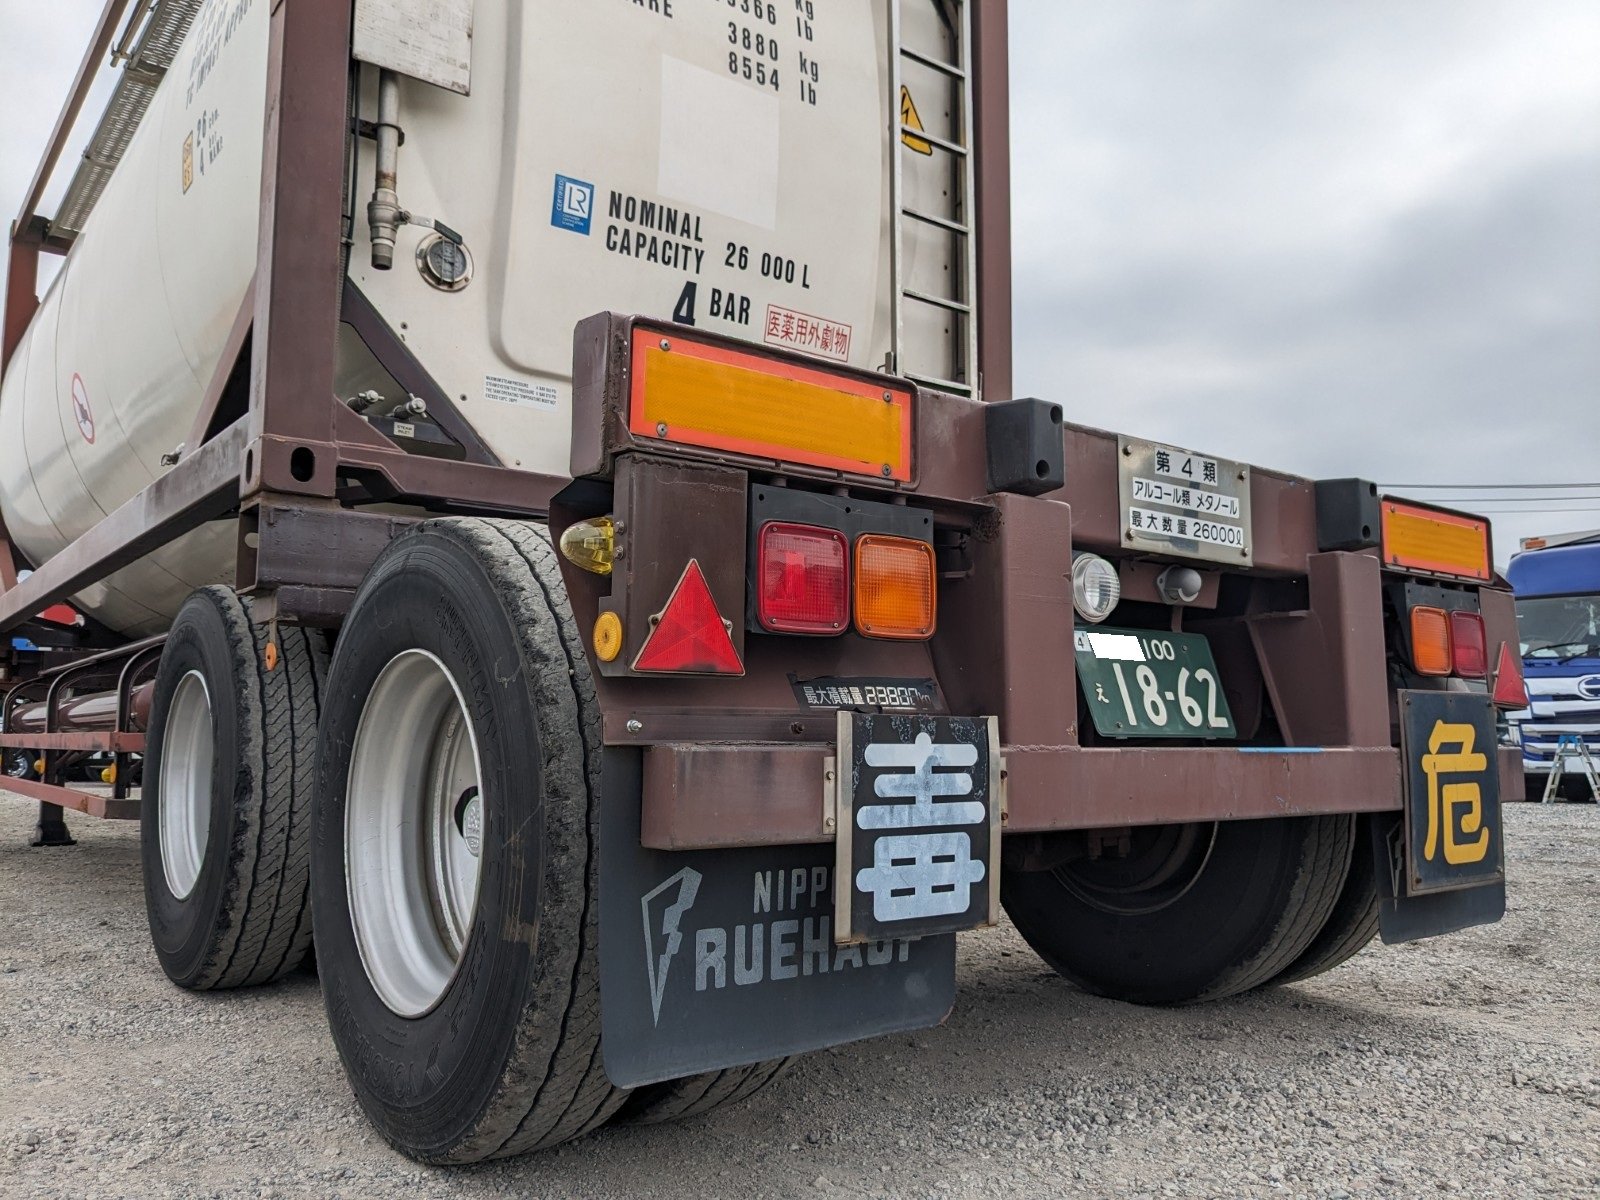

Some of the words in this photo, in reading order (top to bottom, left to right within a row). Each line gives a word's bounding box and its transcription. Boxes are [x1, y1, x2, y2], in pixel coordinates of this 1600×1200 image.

[728, 22, 778, 61] 3880
[799, 51, 819, 83] kg
[796, 16, 813, 42] lb
[728, 51, 779, 91] 8554
[800, 80, 816, 105] lb
[608, 190, 703, 243] NOMINAL
[606, 224, 705, 275] CAPACITY
[724, 242, 749, 271] 26
[761, 252, 795, 284] 000
[802, 264, 810, 289] L
[672, 281, 698, 327] 4
[709, 288, 751, 325] BAR
[766, 310, 849, 356] 医薬用外劇物
[1134, 480, 1191, 506] アルコール類
[1196, 493, 1238, 516] メタノール
[1142, 638, 1175, 661] 100
[1095, 682, 1110, 704] え
[1112, 662, 1229, 728] 18-62
[1422, 719, 1489, 865] 危
[856, 731, 986, 922] 毒
[753, 865, 836, 914] NIPP
